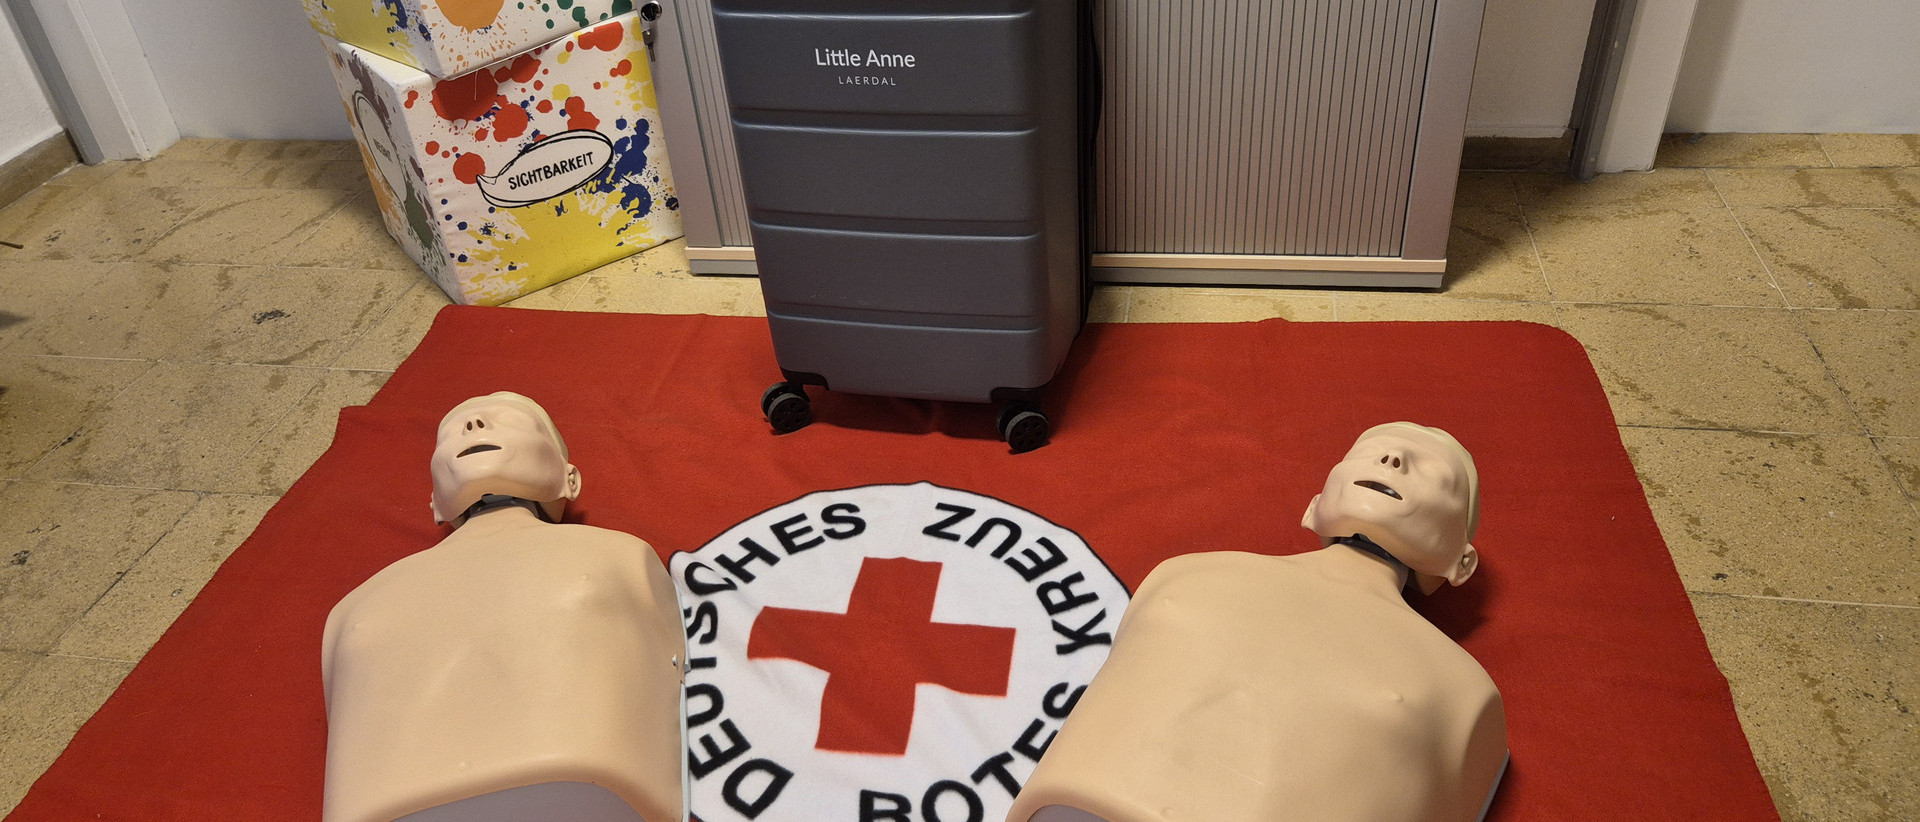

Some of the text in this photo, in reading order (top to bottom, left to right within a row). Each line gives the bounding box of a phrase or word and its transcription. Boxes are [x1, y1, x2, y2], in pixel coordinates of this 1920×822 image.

[815, 48, 916, 68] Little Anne
[838, 76, 896, 86] LAERDAL
[508, 151, 595, 190] SICHTBARKEIT
[922, 502, 1112, 655] KREUZ
